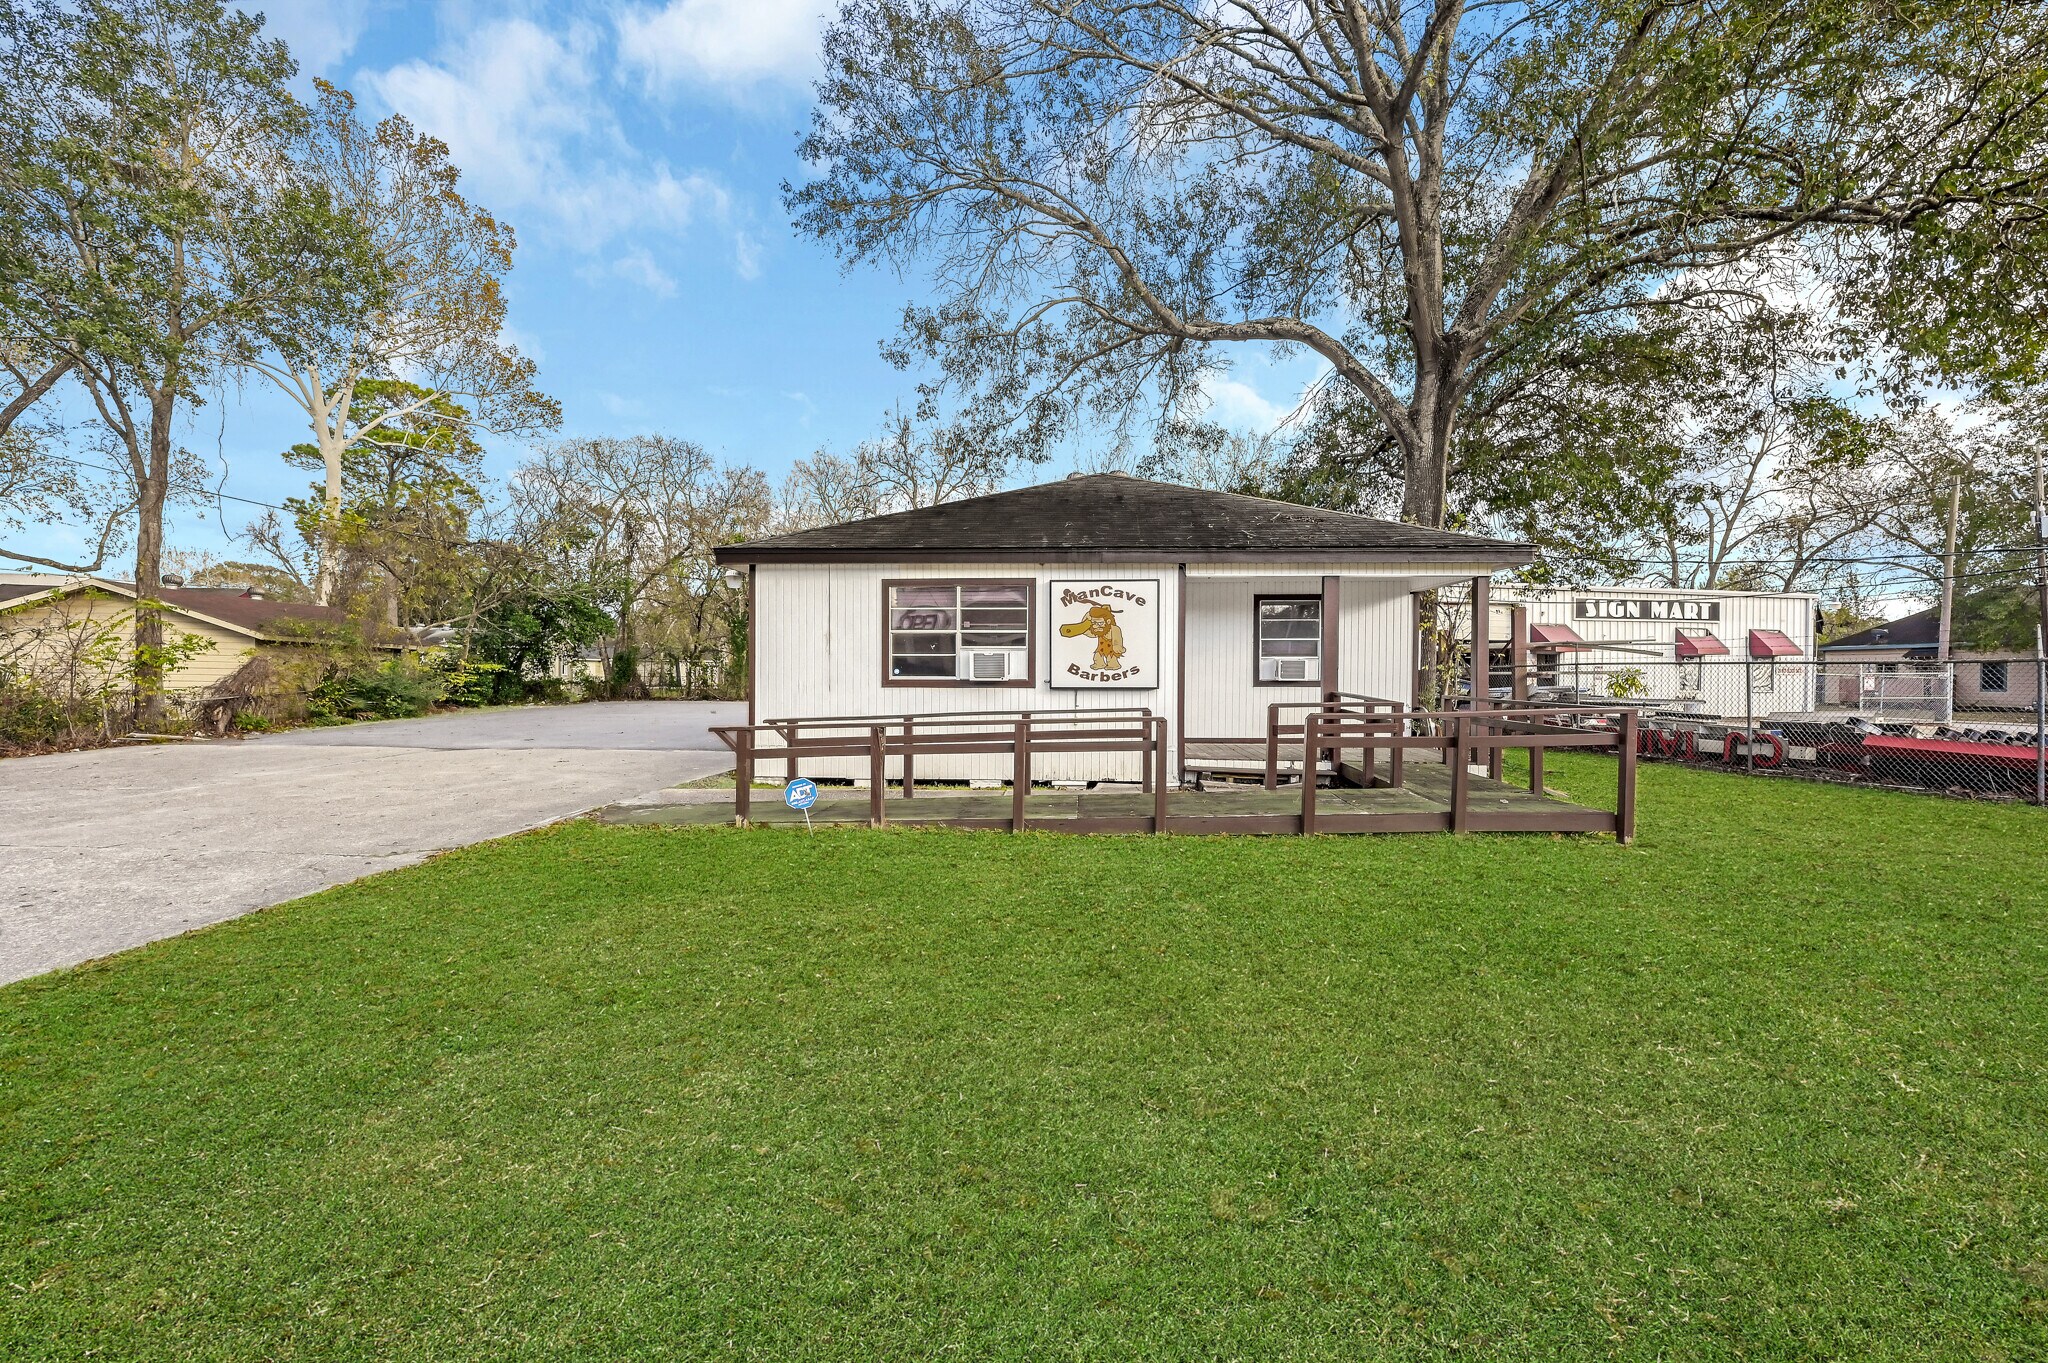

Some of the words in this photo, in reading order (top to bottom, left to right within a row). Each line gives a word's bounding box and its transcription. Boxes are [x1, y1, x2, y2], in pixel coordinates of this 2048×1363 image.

[1060, 585, 1147, 607] ManCave
[1585, 599, 1641, 618] SIGN
[1651, 601, 1712, 620] MART
[1067, 663, 1141, 682] Barbers
[790, 784, 813, 802] ADT
